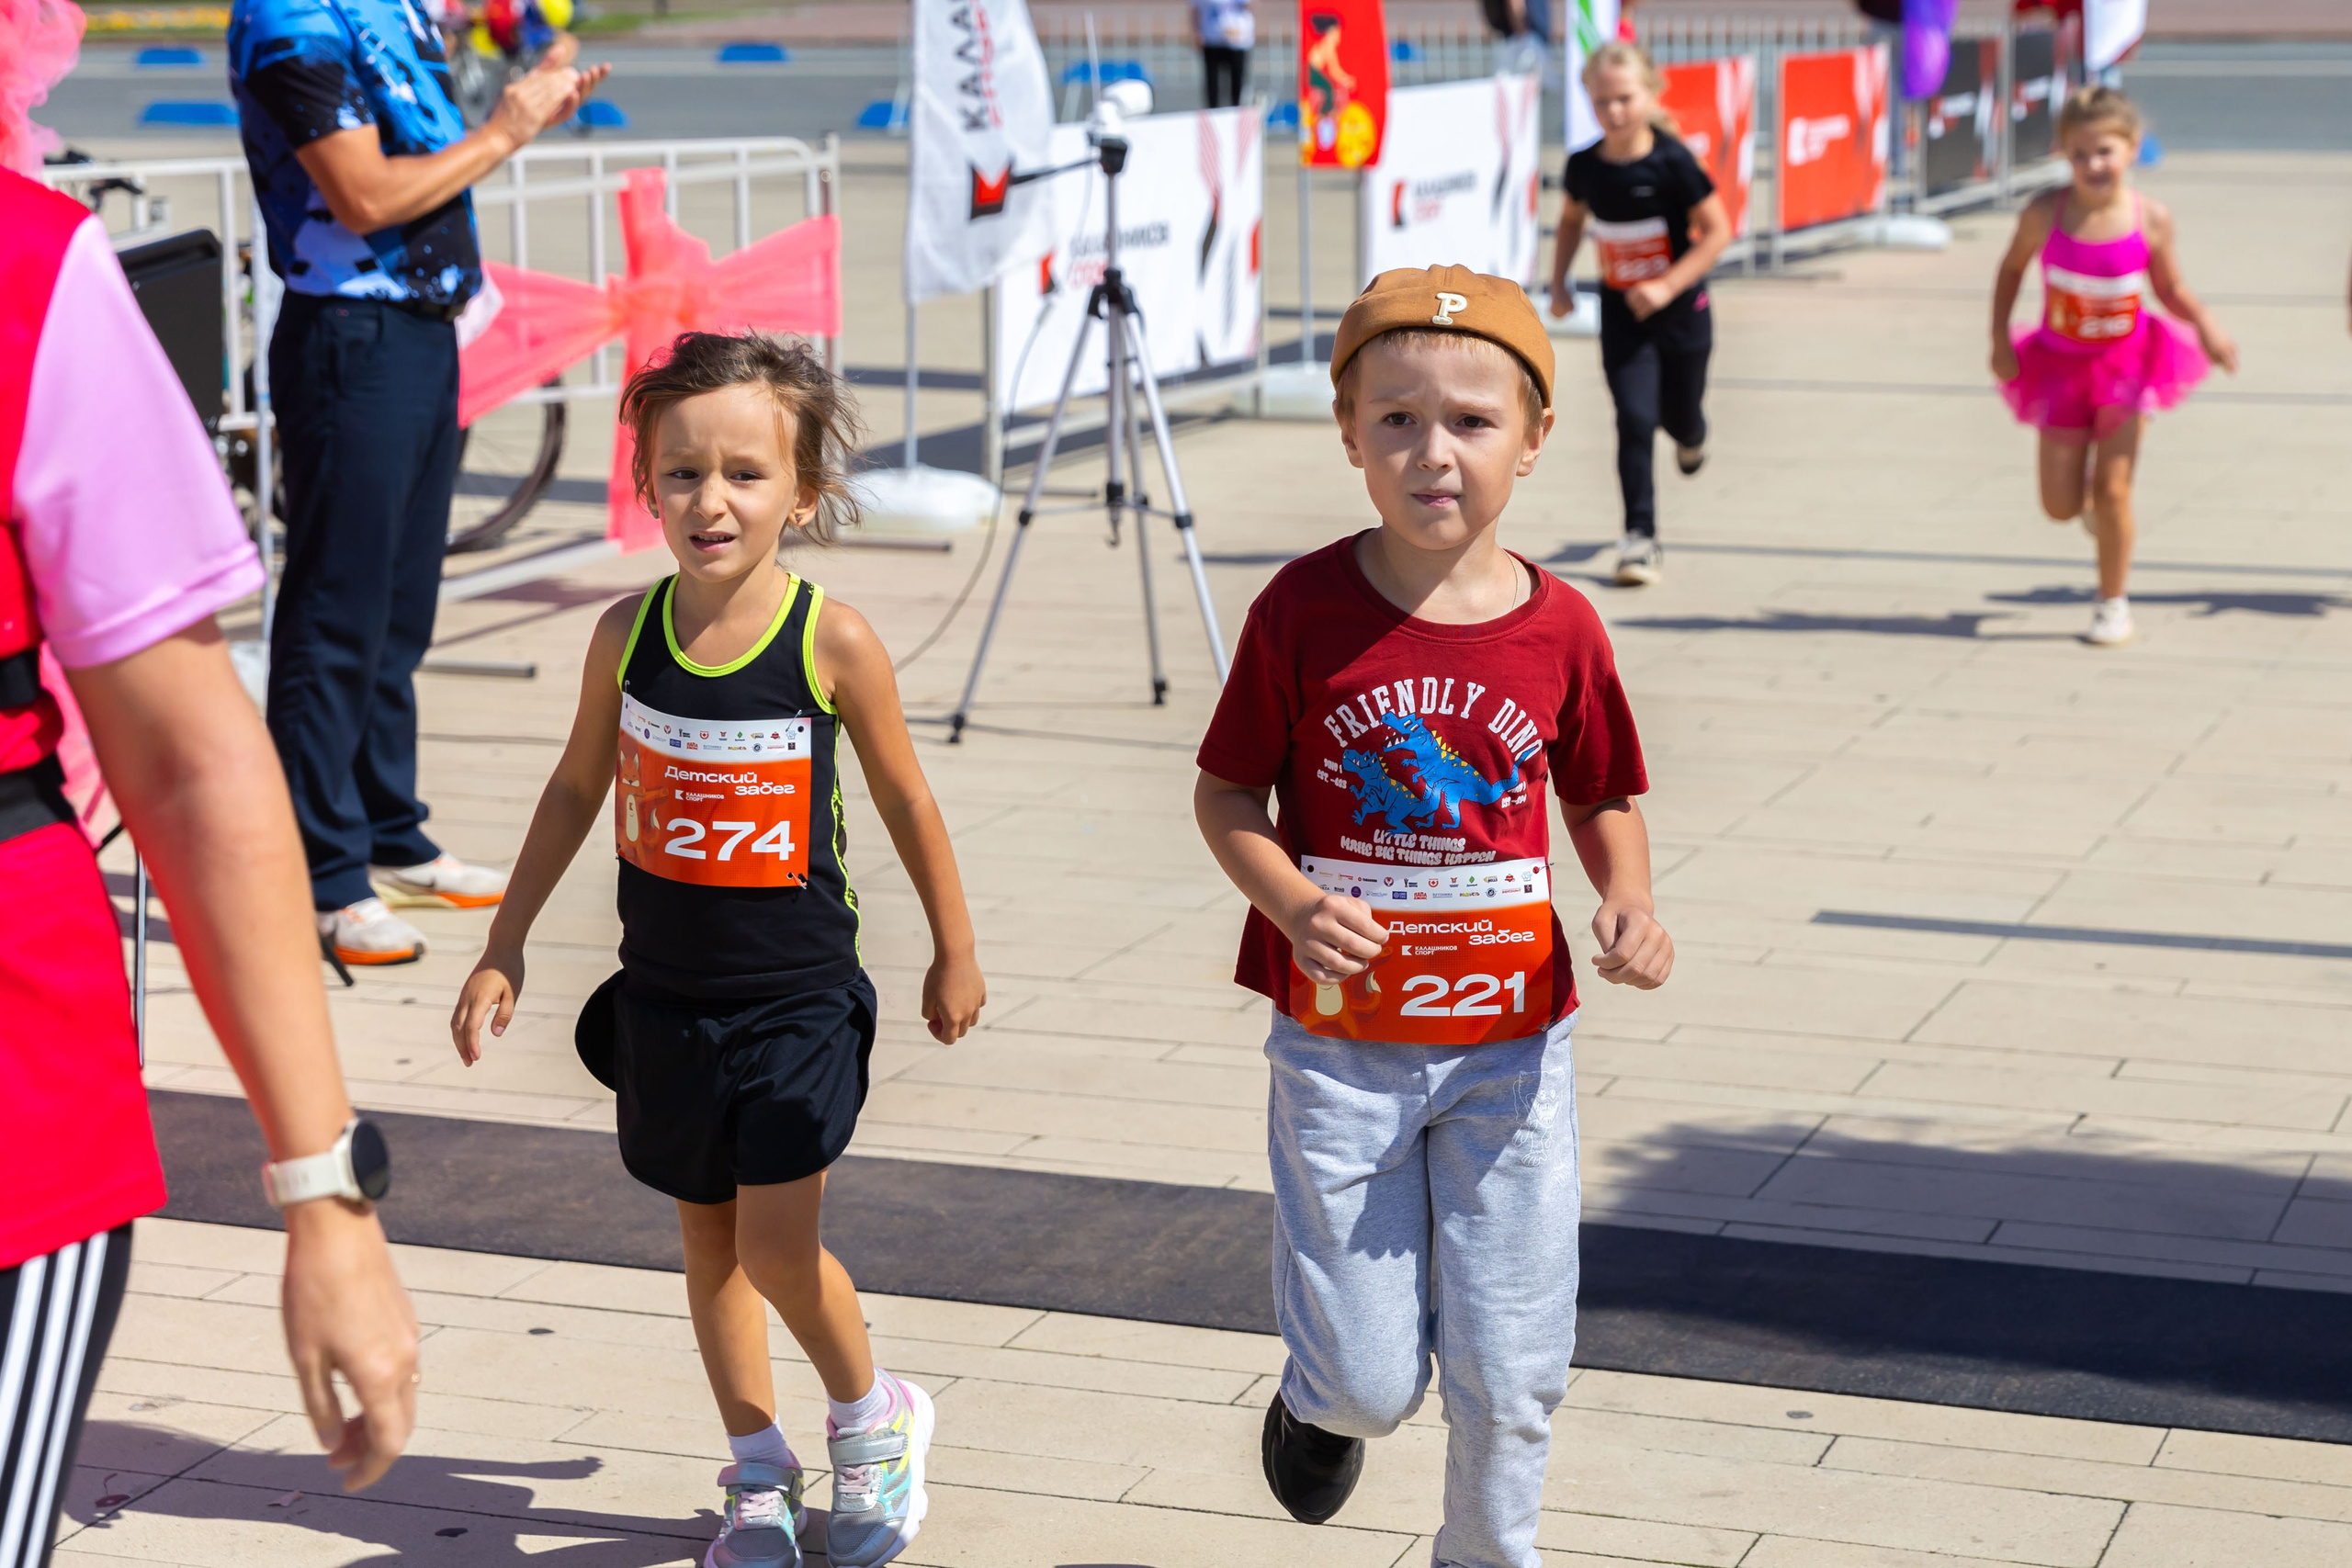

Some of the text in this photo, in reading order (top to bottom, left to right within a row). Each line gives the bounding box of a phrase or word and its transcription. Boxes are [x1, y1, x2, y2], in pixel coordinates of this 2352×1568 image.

[951, 0, 989, 130] КАЛА
[1431, 292, 1467, 325] P
[1323, 677, 1544, 762] FRIENDLY DINO
[664, 765, 757, 784] Детский
[685, 792, 724, 800] КАЛАШНИКОВ
[735, 782, 796, 795] забег
[664, 818, 795, 861] 274
[1340, 836, 1496, 865] MAKE BIG THINGS HAPPEN
[1374, 829, 1466, 852] LITTLE THINGS
[1387, 919, 1493, 935] Детский
[1468, 929, 1535, 945] забег
[1400, 971, 1525, 1016] 221
